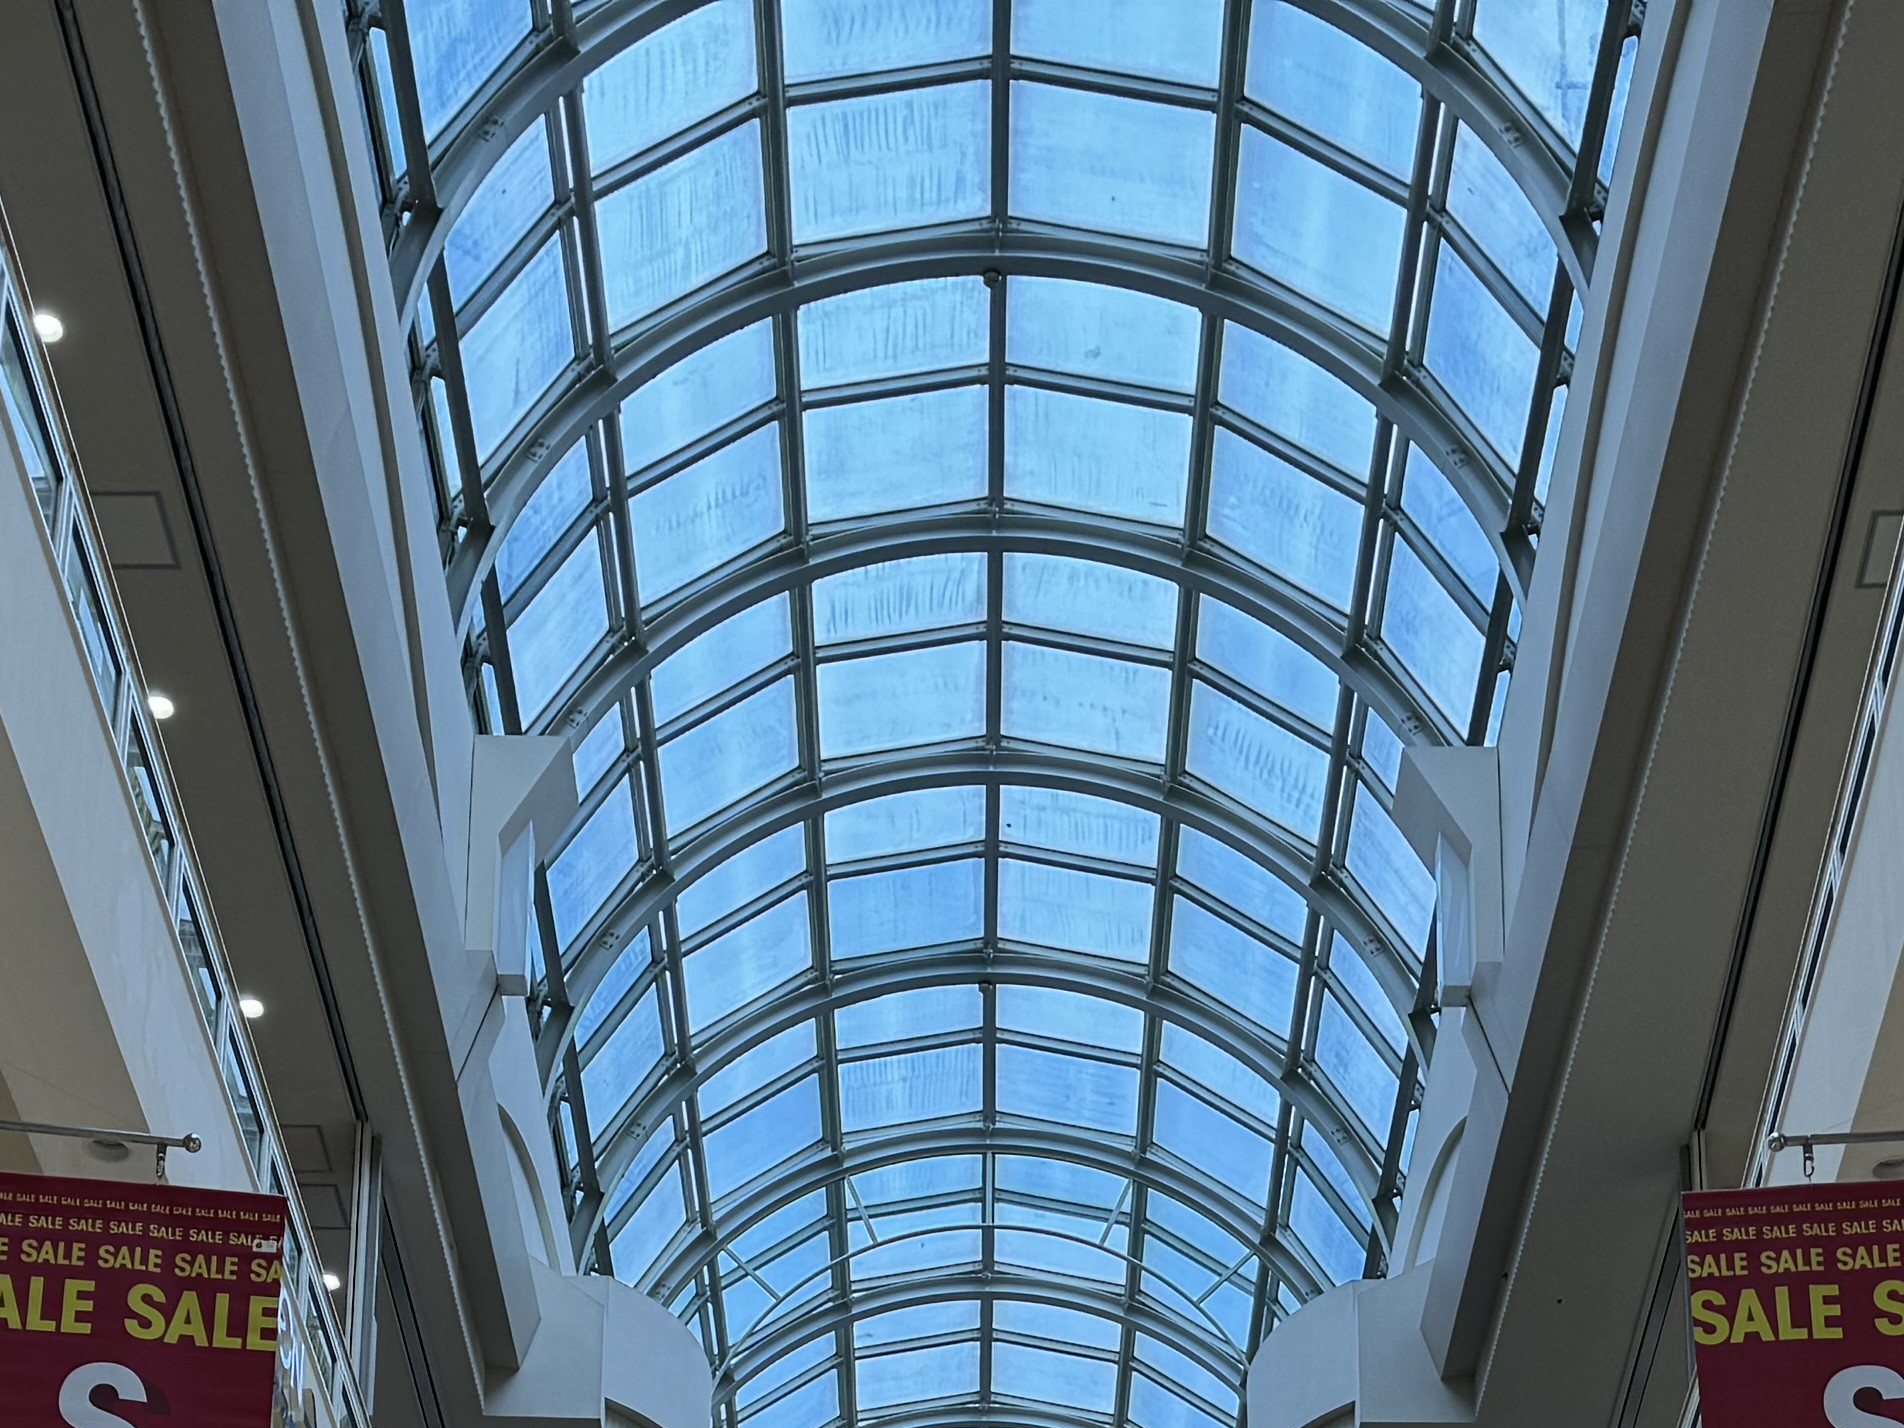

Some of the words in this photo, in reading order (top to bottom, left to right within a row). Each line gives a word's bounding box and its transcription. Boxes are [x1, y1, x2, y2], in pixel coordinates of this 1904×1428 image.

[28, 1215, 63, 1230] SALE
[68, 1218, 103, 1233] SALE
[109, 1221, 143, 1235] SALE
[149, 1224, 183, 1240] SALE
[189, 1228, 223, 1244] SALE
[1722, 1226, 1757, 1241] SALE
[1762, 1224, 1797, 1239] SALE
[1802, 1222, 1837, 1236] SALE
[1842, 1220, 1877, 1235] SALE
[20, 1239, 86, 1266] SALE
[97, 1245, 163, 1273] SALE
[174, 1253, 239, 1280] SALE
[1688, 1252, 1749, 1278] SALE
[1760, 1247, 1825, 1275] SALE
[1836, 1243, 1902, 1271] SALE
[124, 1283, 277, 1352] SALE
[1691, 1284, 1844, 1345] SALE
